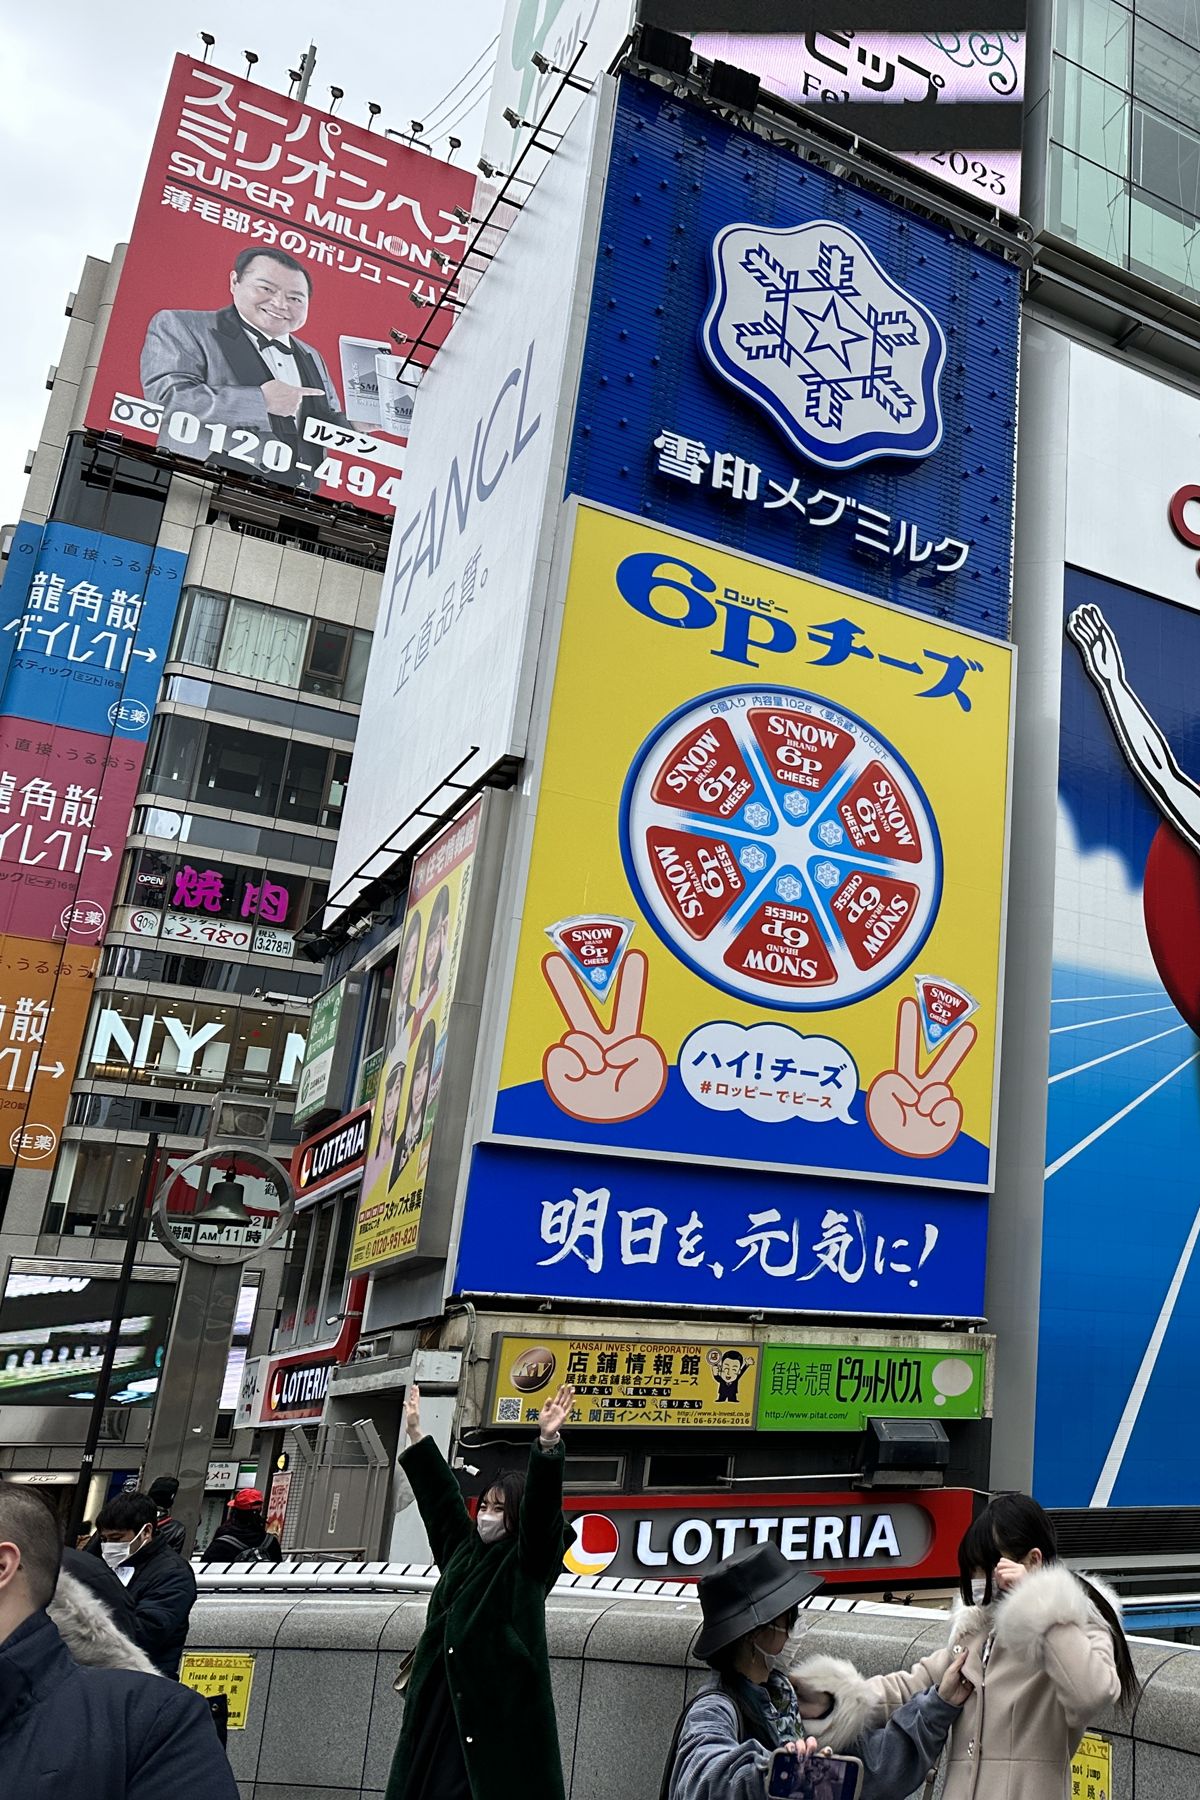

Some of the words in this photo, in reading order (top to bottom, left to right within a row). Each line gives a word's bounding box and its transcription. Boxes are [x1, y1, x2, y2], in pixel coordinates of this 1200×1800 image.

[184, 69, 388, 167] スーパー
[930, 151, 1006, 196] 2023
[168, 151, 294, 215] SUPER
[304, 208, 433, 268] MILLION
[309, 424, 378, 454] ルアン
[383, 339, 541, 640] FANCL
[653, 429, 970, 572] 雪印メグミルク
[27, 571, 147, 632] 龍角散
[723, 588, 789, 614] ロッピー
[3, 615, 133, 674] ダイレクト
[13, 658, 73, 679] スティック
[110, 706, 148, 724] 生薬
[710, 697, 747, 715] 6個入り
[767, 715, 839, 749] SNOW
[787, 739, 818, 753] BRAND
[666, 729, 721, 793] SNOW
[694, 758, 717, 785] BRAND
[776, 746, 822, 776] 6P
[698, 765, 738, 803] 6P
[776, 769, 820, 788] CHEESE
[719, 779, 751, 815] CHEESE
[841, 804, 866, 847] CHEESE
[855, 797, 881, 844] 6P
[873, 779, 915, 847] SNOW
[873, 802, 891, 833] BRAND
[138, 874, 164, 886] OPEN
[684, 860, 704, 893] BRAND
[715, 844, 741, 889] CHEESE
[172, 865, 289, 923] 焼肉
[655, 845, 703, 920] SNOW
[833, 875, 862, 911] CHEESE
[64, 910, 103, 925] 生薬
[765, 905, 809, 923] CHEESE
[865, 904, 886, 928] BRAND
[866, 894, 909, 958] SNOW
[571, 928, 613, 942] SNOW
[766, 944, 799, 954] BRAND
[580, 945, 608, 958] 6P
[583, 957, 609, 965] CHEESE
[743, 949, 818, 979] SNOW
[930, 987, 962, 1008] SNOW
[931, 1002, 951, 1018] 6P
[91, 1008, 225, 1075] NY
[14, 1132, 53, 1150] 生薬
[312, 1119, 366, 1177] LOTTERIA
[567, 1351, 700, 1375] 店舗情報館
[569, 1342, 603, 1351] KANSAI
[606, 1343, 637, 1352] INVEST
[639, 1345, 701, 1354] CORPORATION
[282, 1366, 331, 1404] LOTTERIA
[565, 1374, 699, 1386] 居抜き店舗総合プロデュース
[836, 1356, 922, 1403] ピタットハウス
[526, 1408, 582, 1422] 株社
[589, 1409, 672, 1423] 関西インベスト
[765, 1410, 848, 1420] http://www.pitat.com/
[636, 1513, 901, 1568] LOTTERIA
[188, 1672, 207, 1680] Please
[210, 1672, 216, 1680] do
[219, 1673, 228, 1681] not
[231, 1672, 244, 1682] jump
